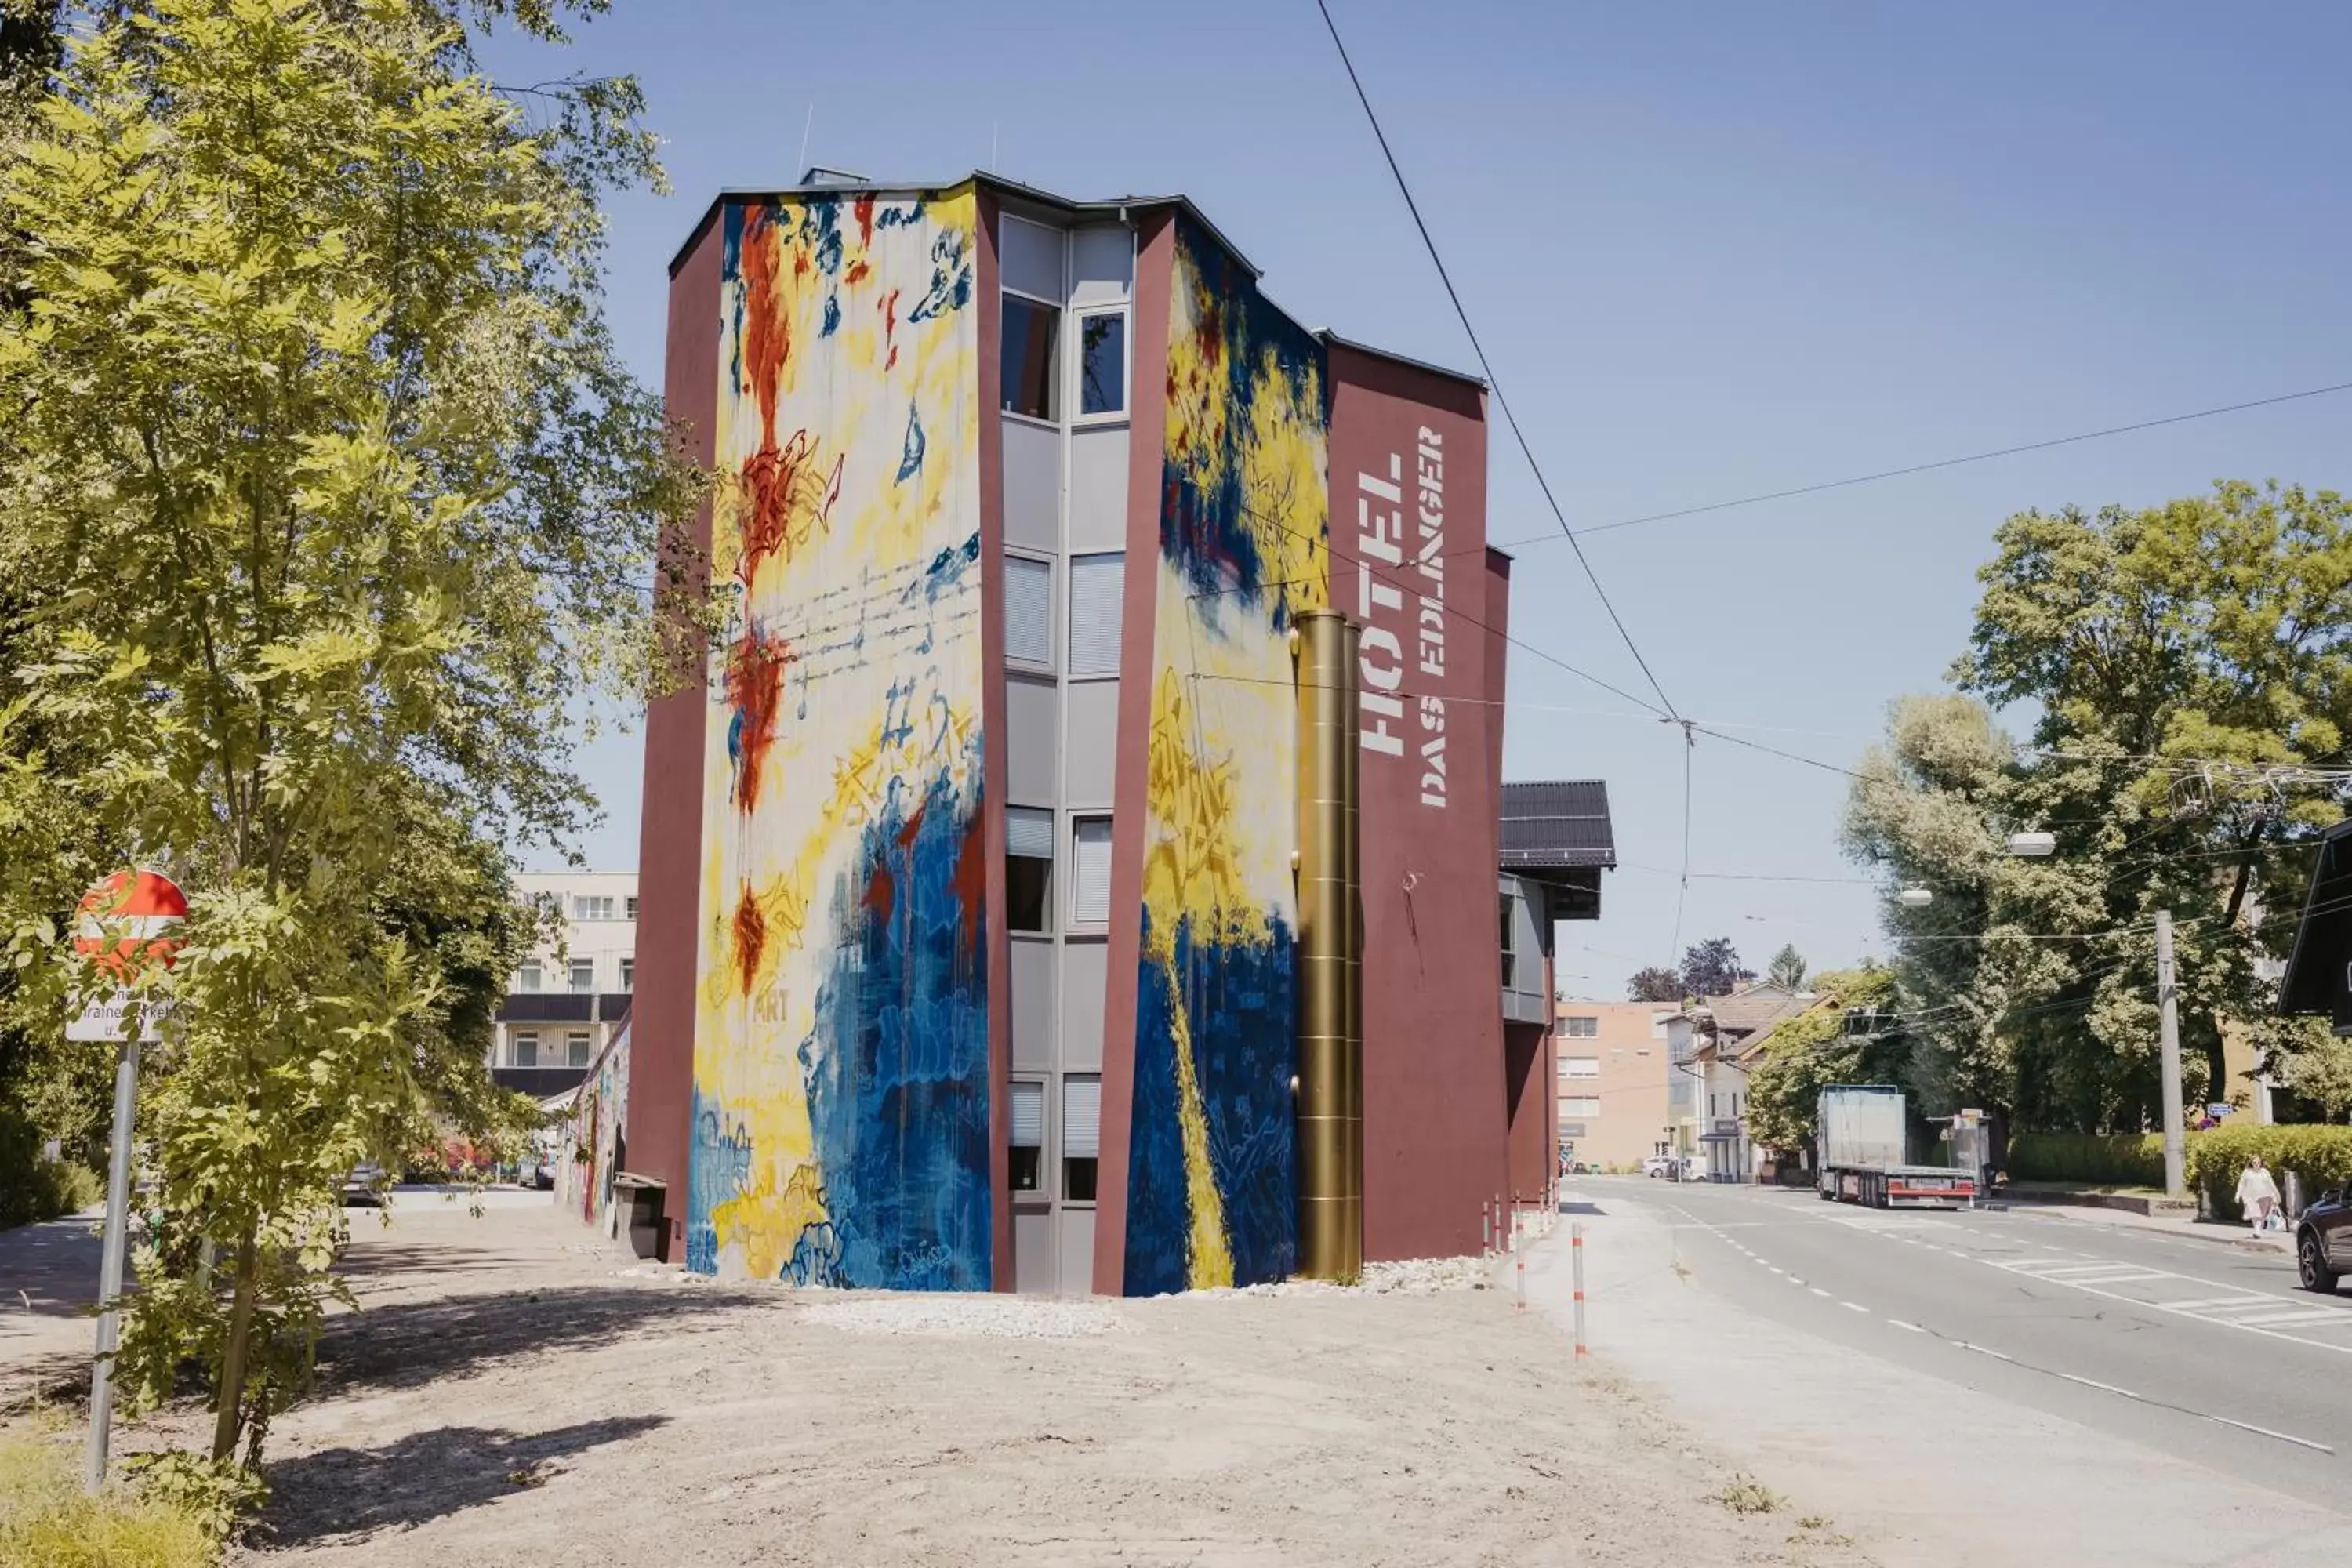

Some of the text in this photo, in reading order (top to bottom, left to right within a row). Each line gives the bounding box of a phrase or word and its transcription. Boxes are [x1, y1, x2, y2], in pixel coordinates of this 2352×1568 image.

[1359, 452, 1403, 757] HOTEL
[1418, 426, 1446, 808] DAS EDLINGER
